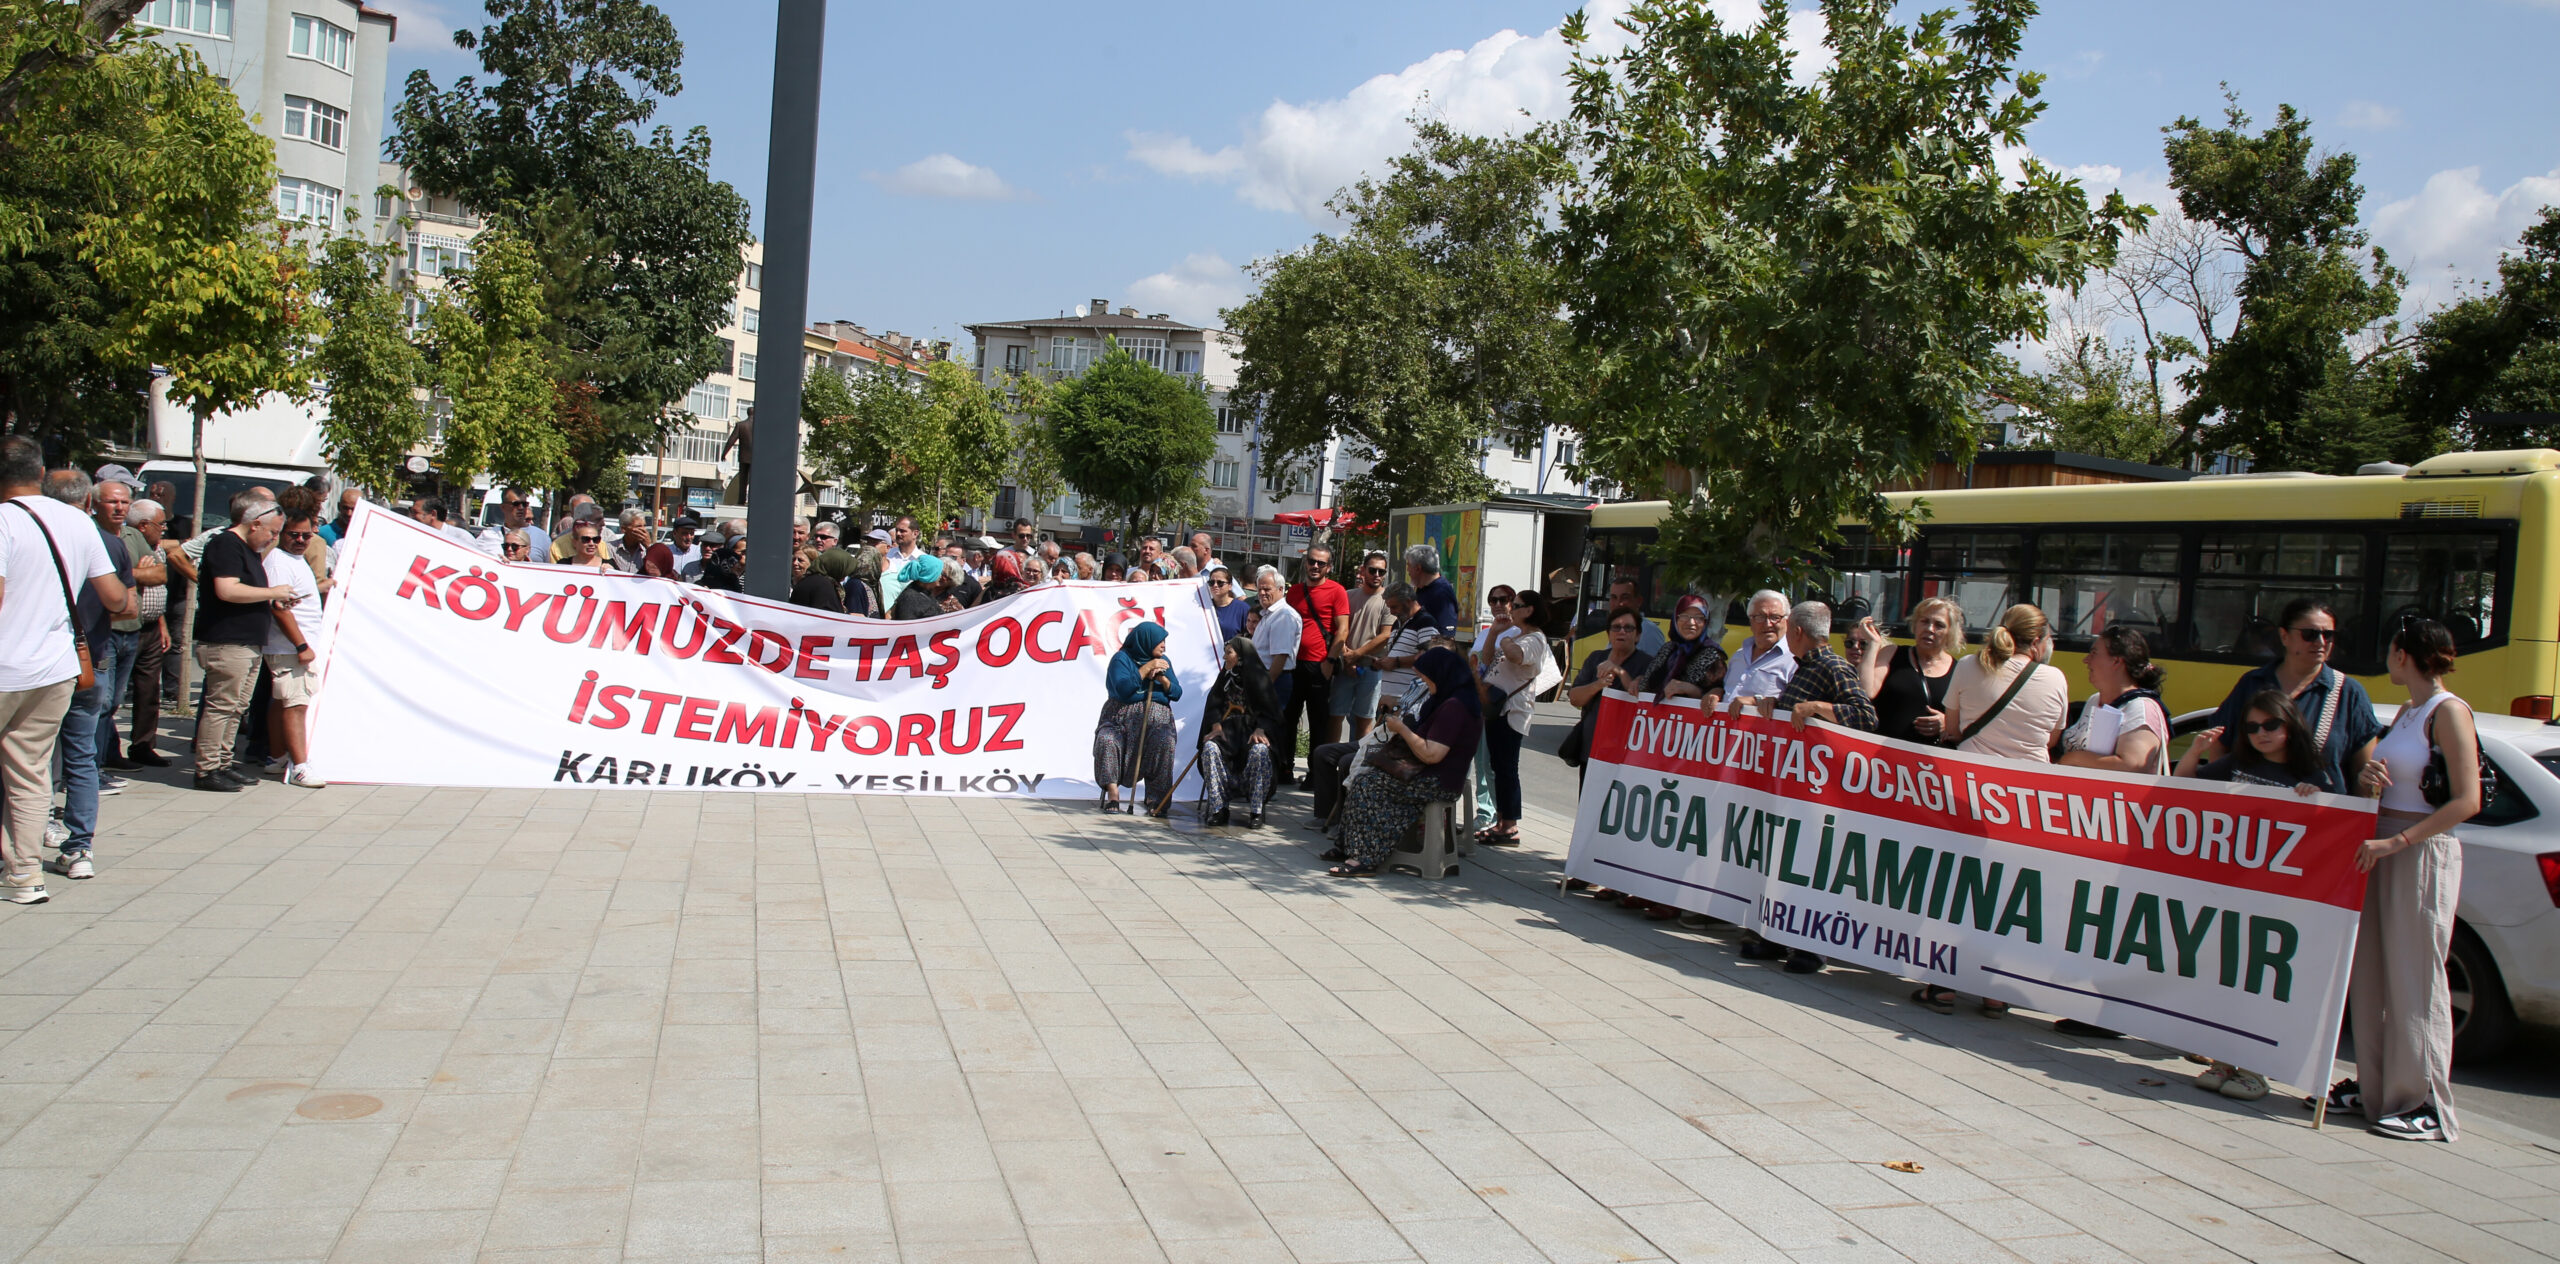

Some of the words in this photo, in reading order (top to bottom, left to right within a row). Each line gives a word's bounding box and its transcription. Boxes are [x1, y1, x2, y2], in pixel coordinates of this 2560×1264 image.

[396, 555, 836, 680] KÖYÜMÜZDE
[848, 628, 960, 690] TAŞ
[567, 670, 1026, 757] İSTEMİYORUZ
[1625, 708, 1767, 773] ÖYÜMÜZDE
[1771, 737, 1834, 794] TAŞ
[1841, 751, 1957, 816] OCAĞI
[1967, 771, 2307, 877] İSTEMİYORUZ
[1598, 777, 1708, 857] DOĞA
[1721, 802, 2042, 944] KATLİAMINA
[2064, 878, 2299, 1003] HAYIR
[1758, 893, 1869, 950] KARLIKÖY
[1873, 926, 1958, 976] HALKI
